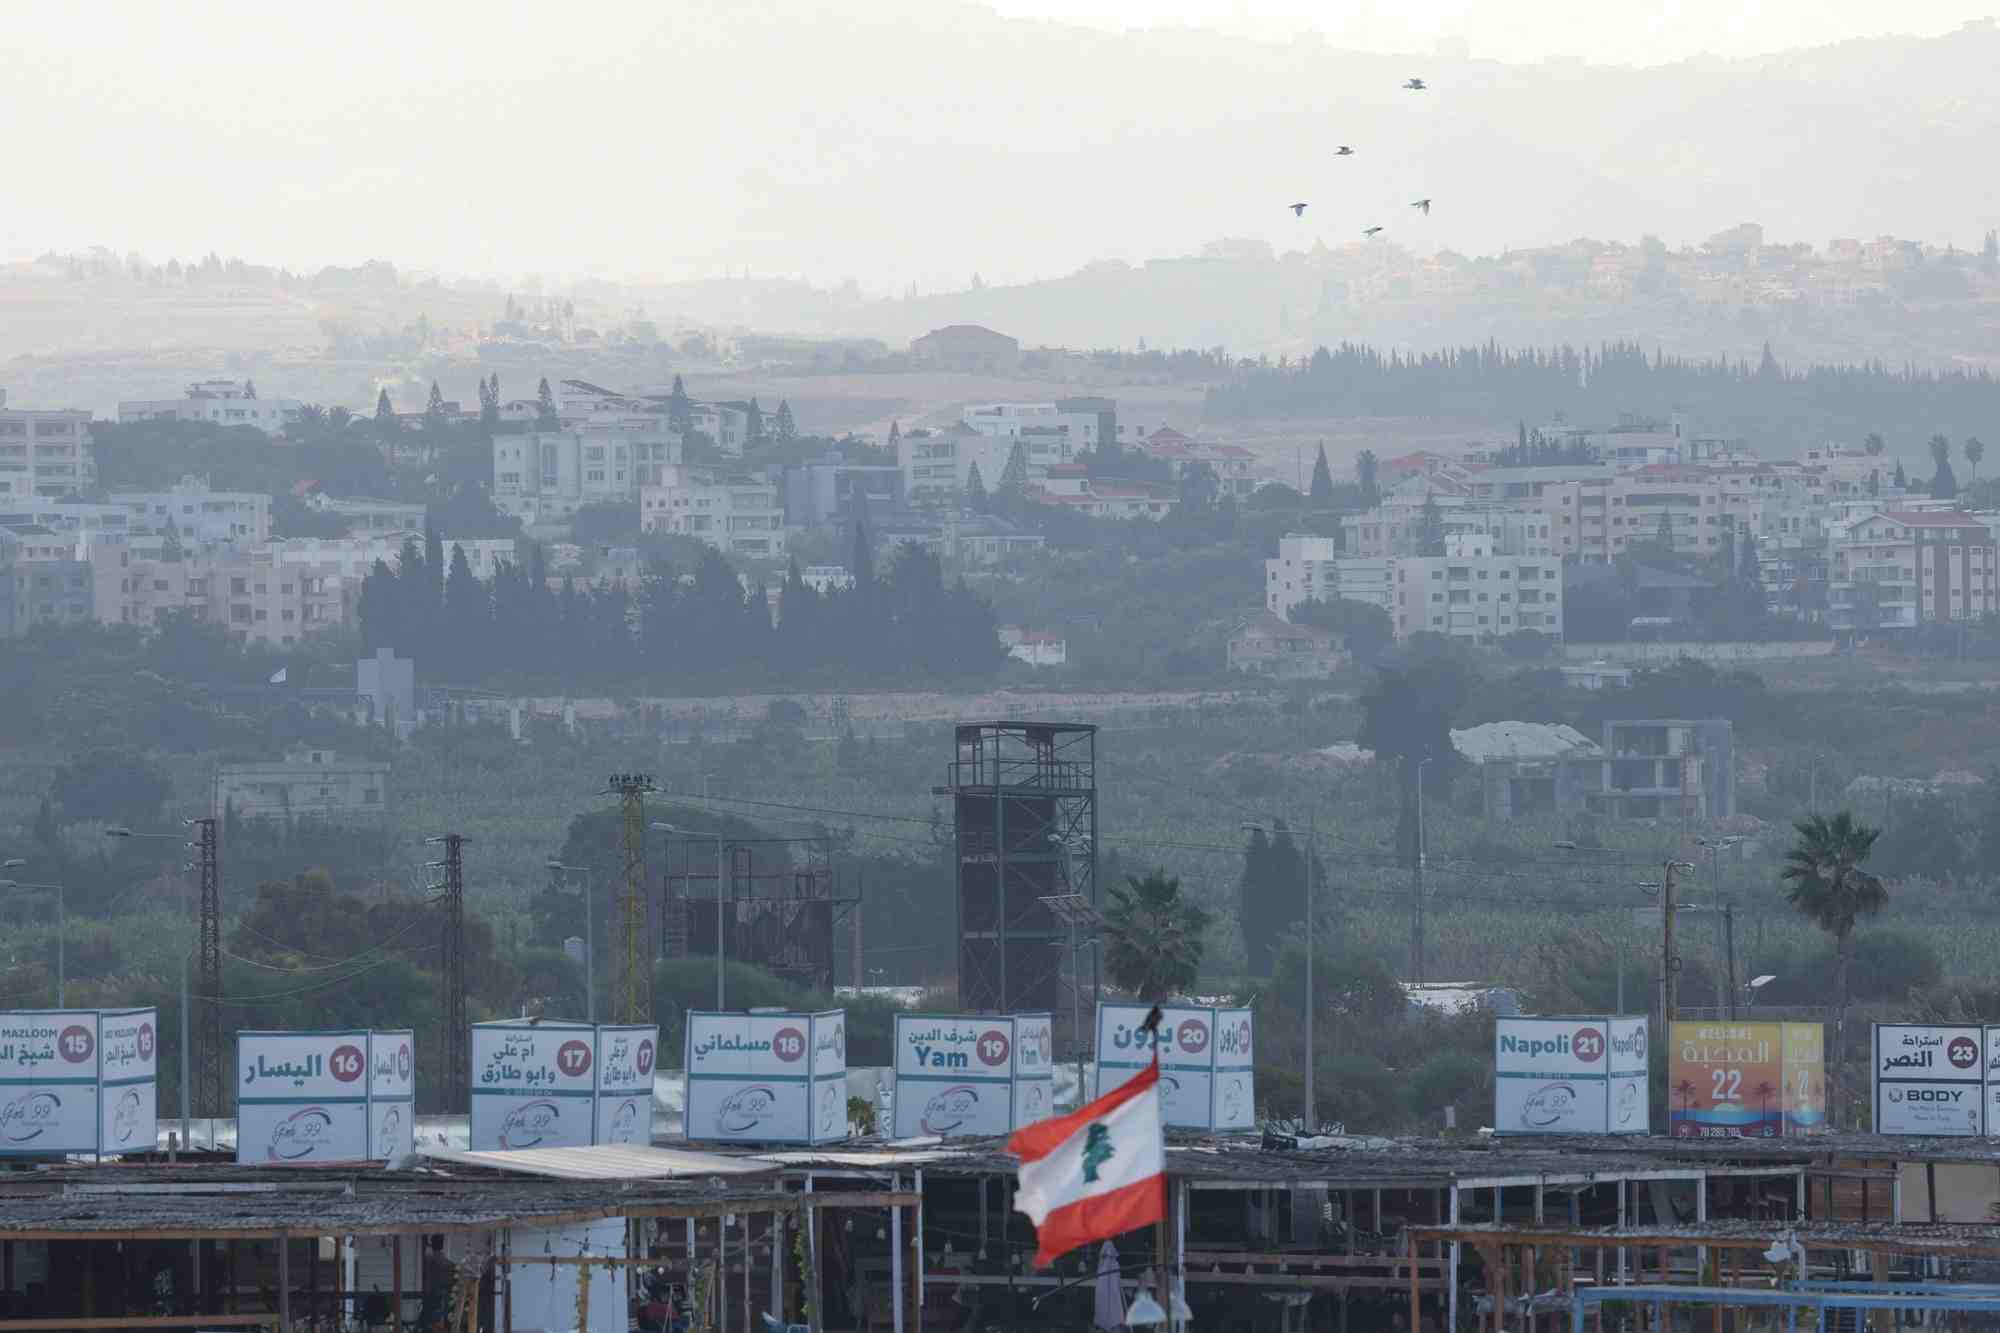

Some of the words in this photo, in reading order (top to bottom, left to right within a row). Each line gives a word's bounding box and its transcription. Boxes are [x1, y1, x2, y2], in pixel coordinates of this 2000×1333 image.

[2, 1028, 58, 1039] MAZLOOM
[140, 1032, 152, 1052] 15
[908, 1029, 941, 1045] الدين
[946, 1028, 977, 1045] شرف
[1181, 1028, 1205, 1044] 20
[1902, 1034, 1943, 1048] استراحة
[64, 1034, 88, 1054] 15
[694, 1033, 772, 1061] مسلماني
[780, 1037, 800, 1053] 18
[983, 1039, 1004, 1057] 19
[1501, 1034, 1569, 1058] Napoli
[1577, 1036, 1600, 1054] 21
[1952, 1045, 1974, 1060] 23
[18, 1043, 55, 1066] شيخ
[492, 1043, 519, 1065] علي
[563, 1050, 587, 1066] 17
[639, 1049, 651, 1067] 17
[914, 1046, 968, 1067] Yam
[1883, 1050, 1932, 1071] النصر
[244, 1053, 323, 1087] اليسار
[335, 1055, 359, 1073] 16
[481, 1063, 522, 1083] طارق
[1711, 1069, 1742, 1100] 22
[1907, 1090, 1963, 1102] BODY
